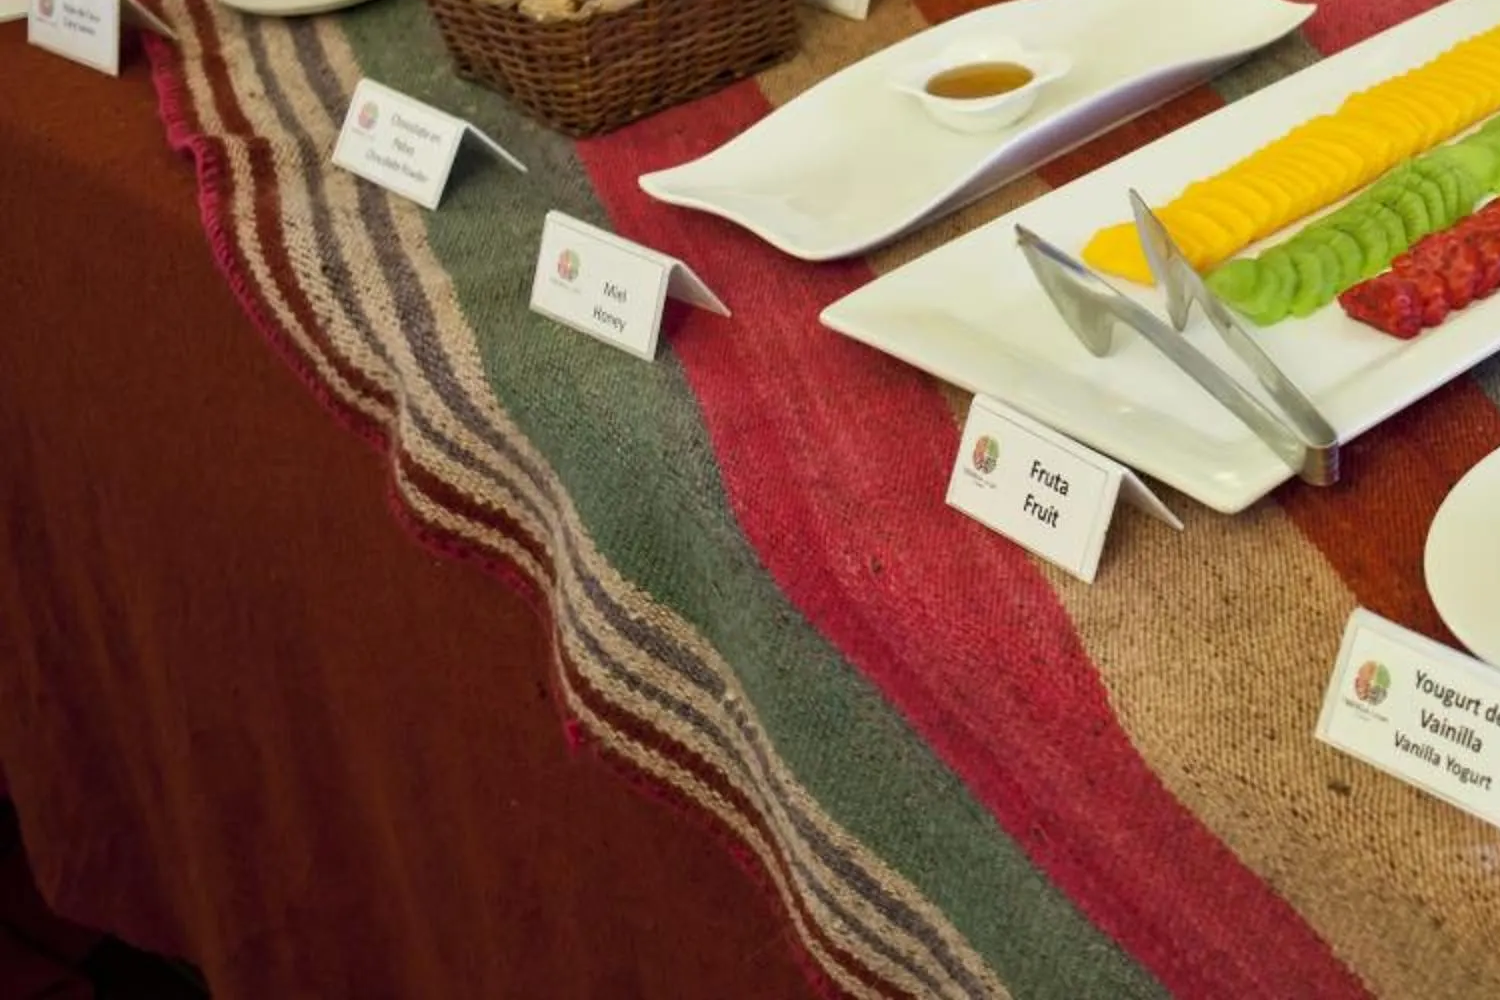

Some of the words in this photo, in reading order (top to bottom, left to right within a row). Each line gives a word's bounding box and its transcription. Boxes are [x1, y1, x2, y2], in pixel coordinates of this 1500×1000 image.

[603, 280, 628, 303] Miel
[592, 304, 627, 333] Honey
[1029, 459, 1070, 496] Fruta
[1023, 493, 1060, 529] Fruit
[1414, 669, 1483, 717] Yougurt
[1420, 708, 1483, 754] Vainilla
[1393, 731, 1442, 766] Vanilla
[1445, 755, 1494, 792] Yogurt
